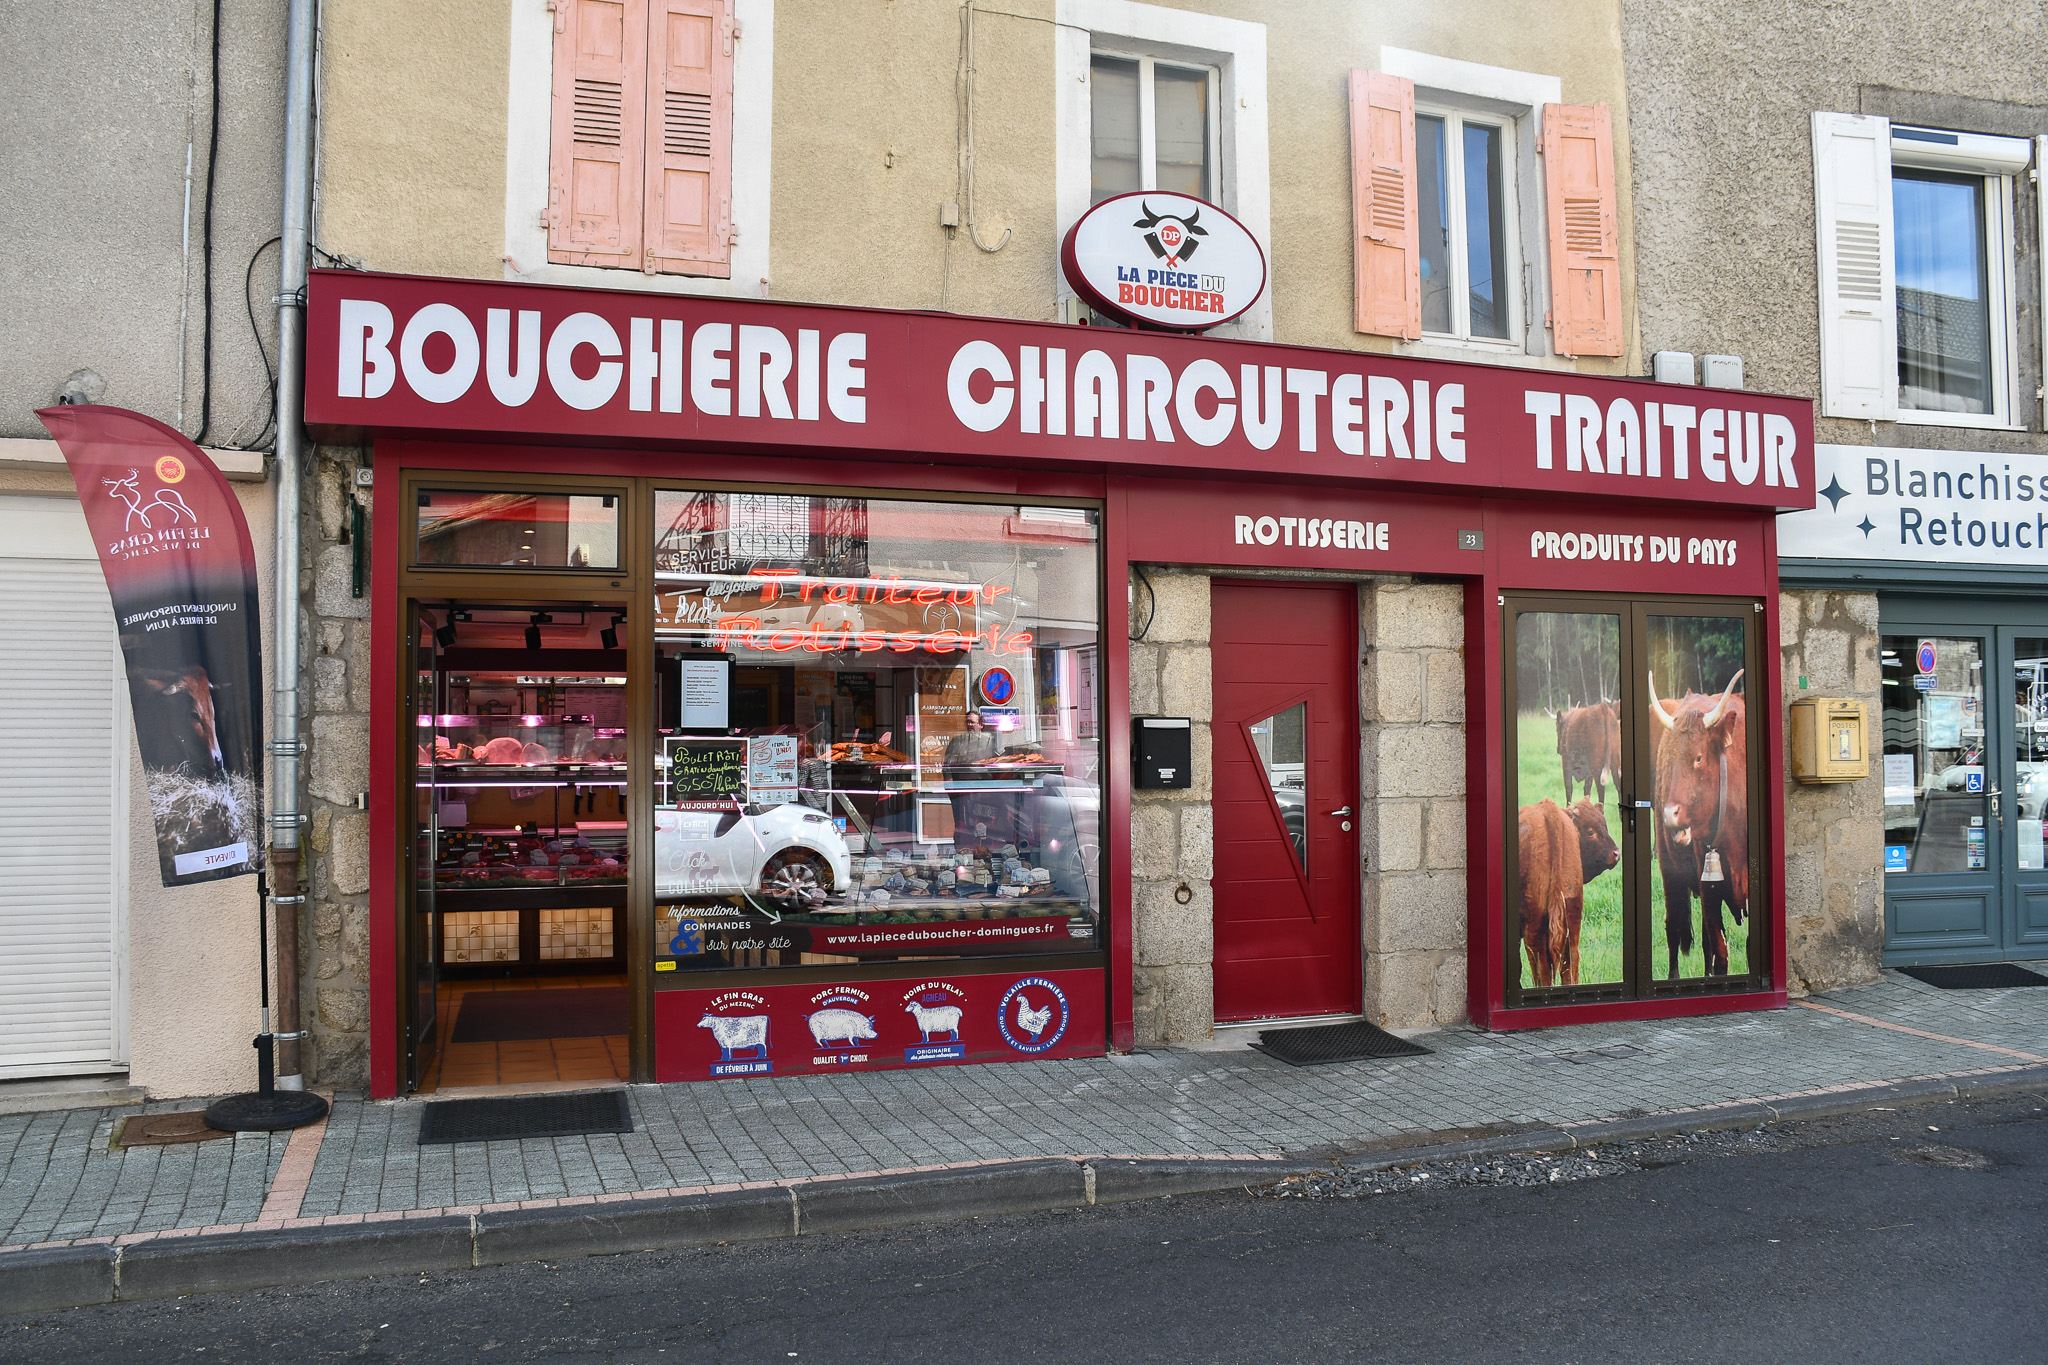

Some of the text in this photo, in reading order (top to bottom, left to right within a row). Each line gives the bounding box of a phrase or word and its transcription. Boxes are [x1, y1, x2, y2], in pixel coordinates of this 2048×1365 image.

[1162, 229, 1180, 242] DP
[1117, 266, 1140, 283] LA
[1201, 274, 1225, 293] DU
[1118, 283, 1225, 314] BOUCHER
[337, 298, 1799, 489] BOUCHERIE CHARCUTERIE TRAITEUR
[1234, 515, 1389, 551] ROTISSERIE
[1465, 534, 1477, 547] 23
[671, 546, 728, 564] SERVICE
[1530, 530, 1737, 567] PRODUITS DU PAYS
[671, 560, 737, 575] TRAITEUR
[751, 568, 1011, 606] Traiteur
[716, 616, 1033, 653] Rotisserie
[700, 640, 743, 648] SEMAINE
[674, 747, 714, 765] POULET
[680, 802, 734, 810] AUJOURD'HUI
[669, 849, 707, 872] Click
[668, 880, 720, 894] COLLECT
[668, 904, 740, 922] Informations
[684, 921, 751, 931] COMMANDES
[827, 923, 1054, 945] www.lapieceduboucher-domingues.fr
[670, 919, 702, 955] &
[706, 936, 792, 951] sur notre site
[711, 991, 765, 1007] LE FIN GRAS
[811, 986, 870, 1004] PORC FERMIER
[903, 983, 927, 1001] NOIRE
[941, 982, 964, 997] VELAY
[922, 992, 947, 1003] AGNEAU
[1000, 978, 1066, 1007] VOLAILLE FERMIÈRE
[718, 1001, 756, 1012] DU MEZENC
[822, 996, 859, 1007] D'AUVERGNE
[1046, 1010, 1068, 1048] LABEL ROUGE
[813, 1055, 837, 1065] QUALITE
[850, 1054, 868, 1063] CHOIX
[916, 1047, 952, 1055] ORIGINAIRE
[715, 1063, 768, 1074] DE FÉVRIER À JUIN
